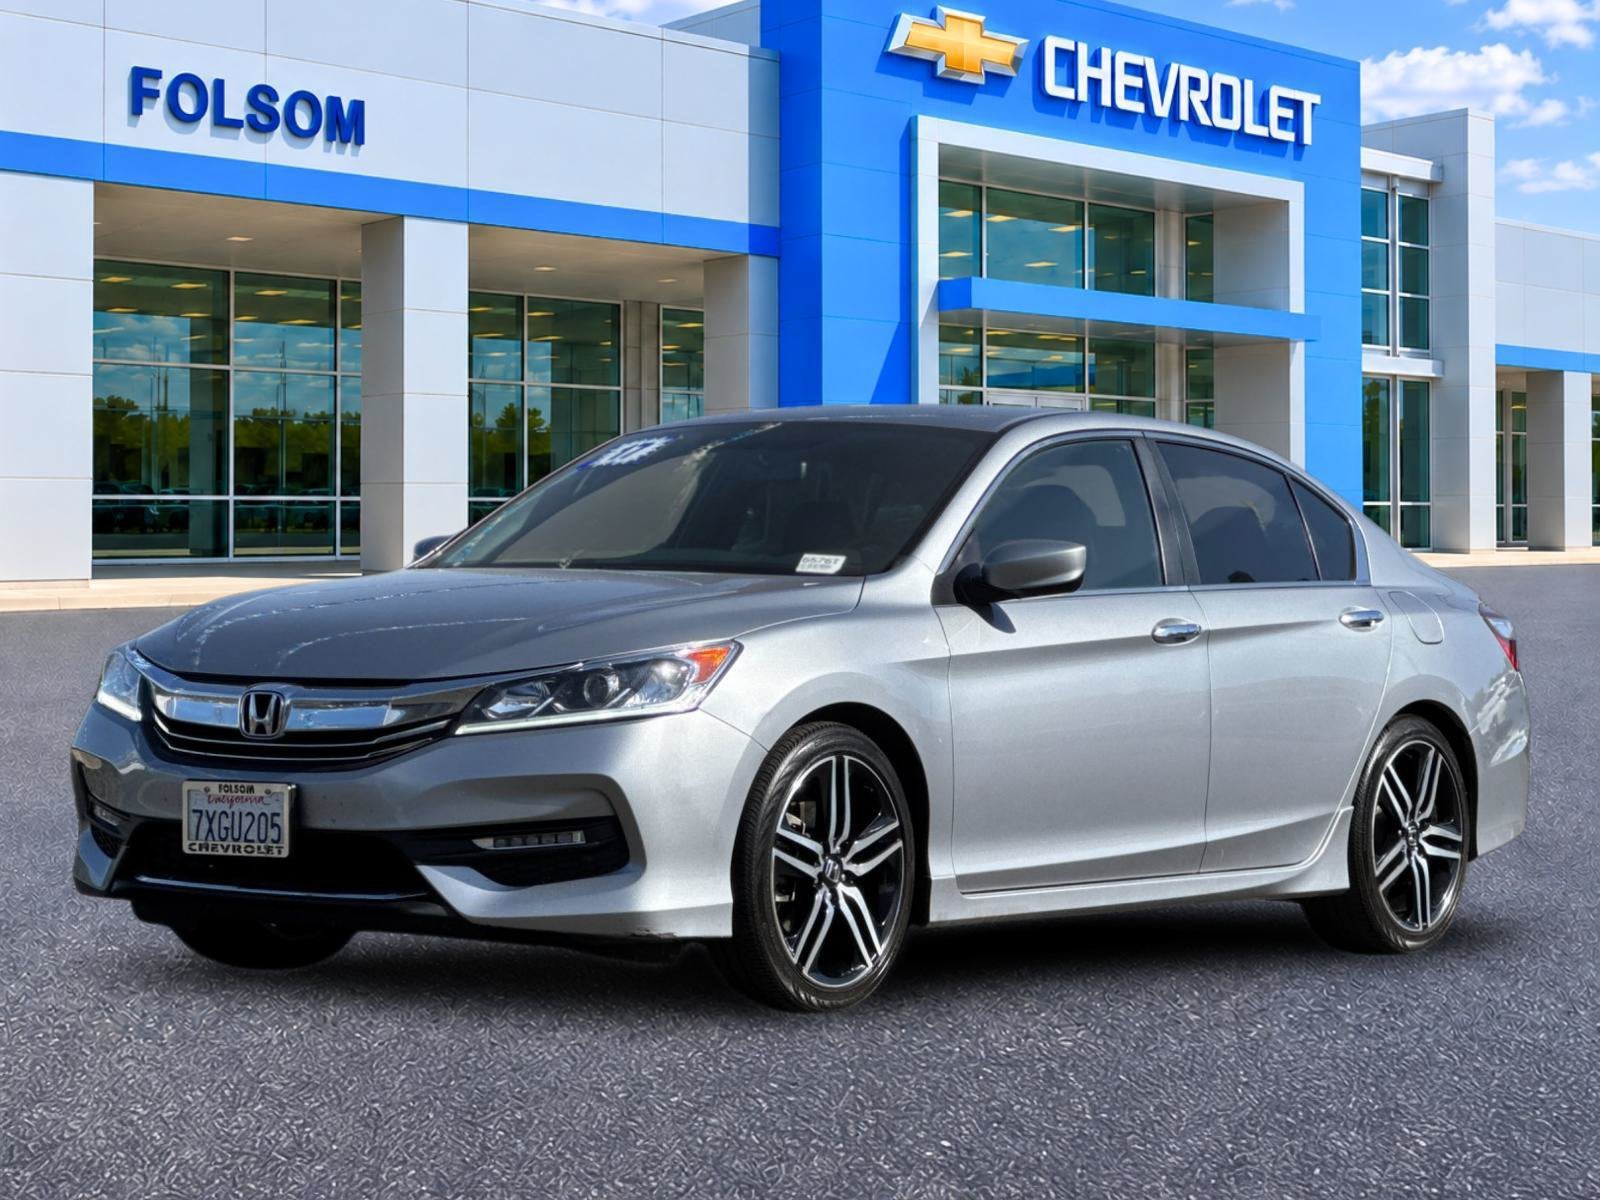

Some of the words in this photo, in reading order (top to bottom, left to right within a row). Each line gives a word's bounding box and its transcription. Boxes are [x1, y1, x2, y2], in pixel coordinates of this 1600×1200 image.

[130, 65, 366, 146] FOLSOM
[1044, 35, 1321, 146] CHEVROLET
[218, 784, 255, 794] FOLSOM
[192, 809, 281, 844] 7XGU205
[188, 842, 284, 855] CHEVROLET
